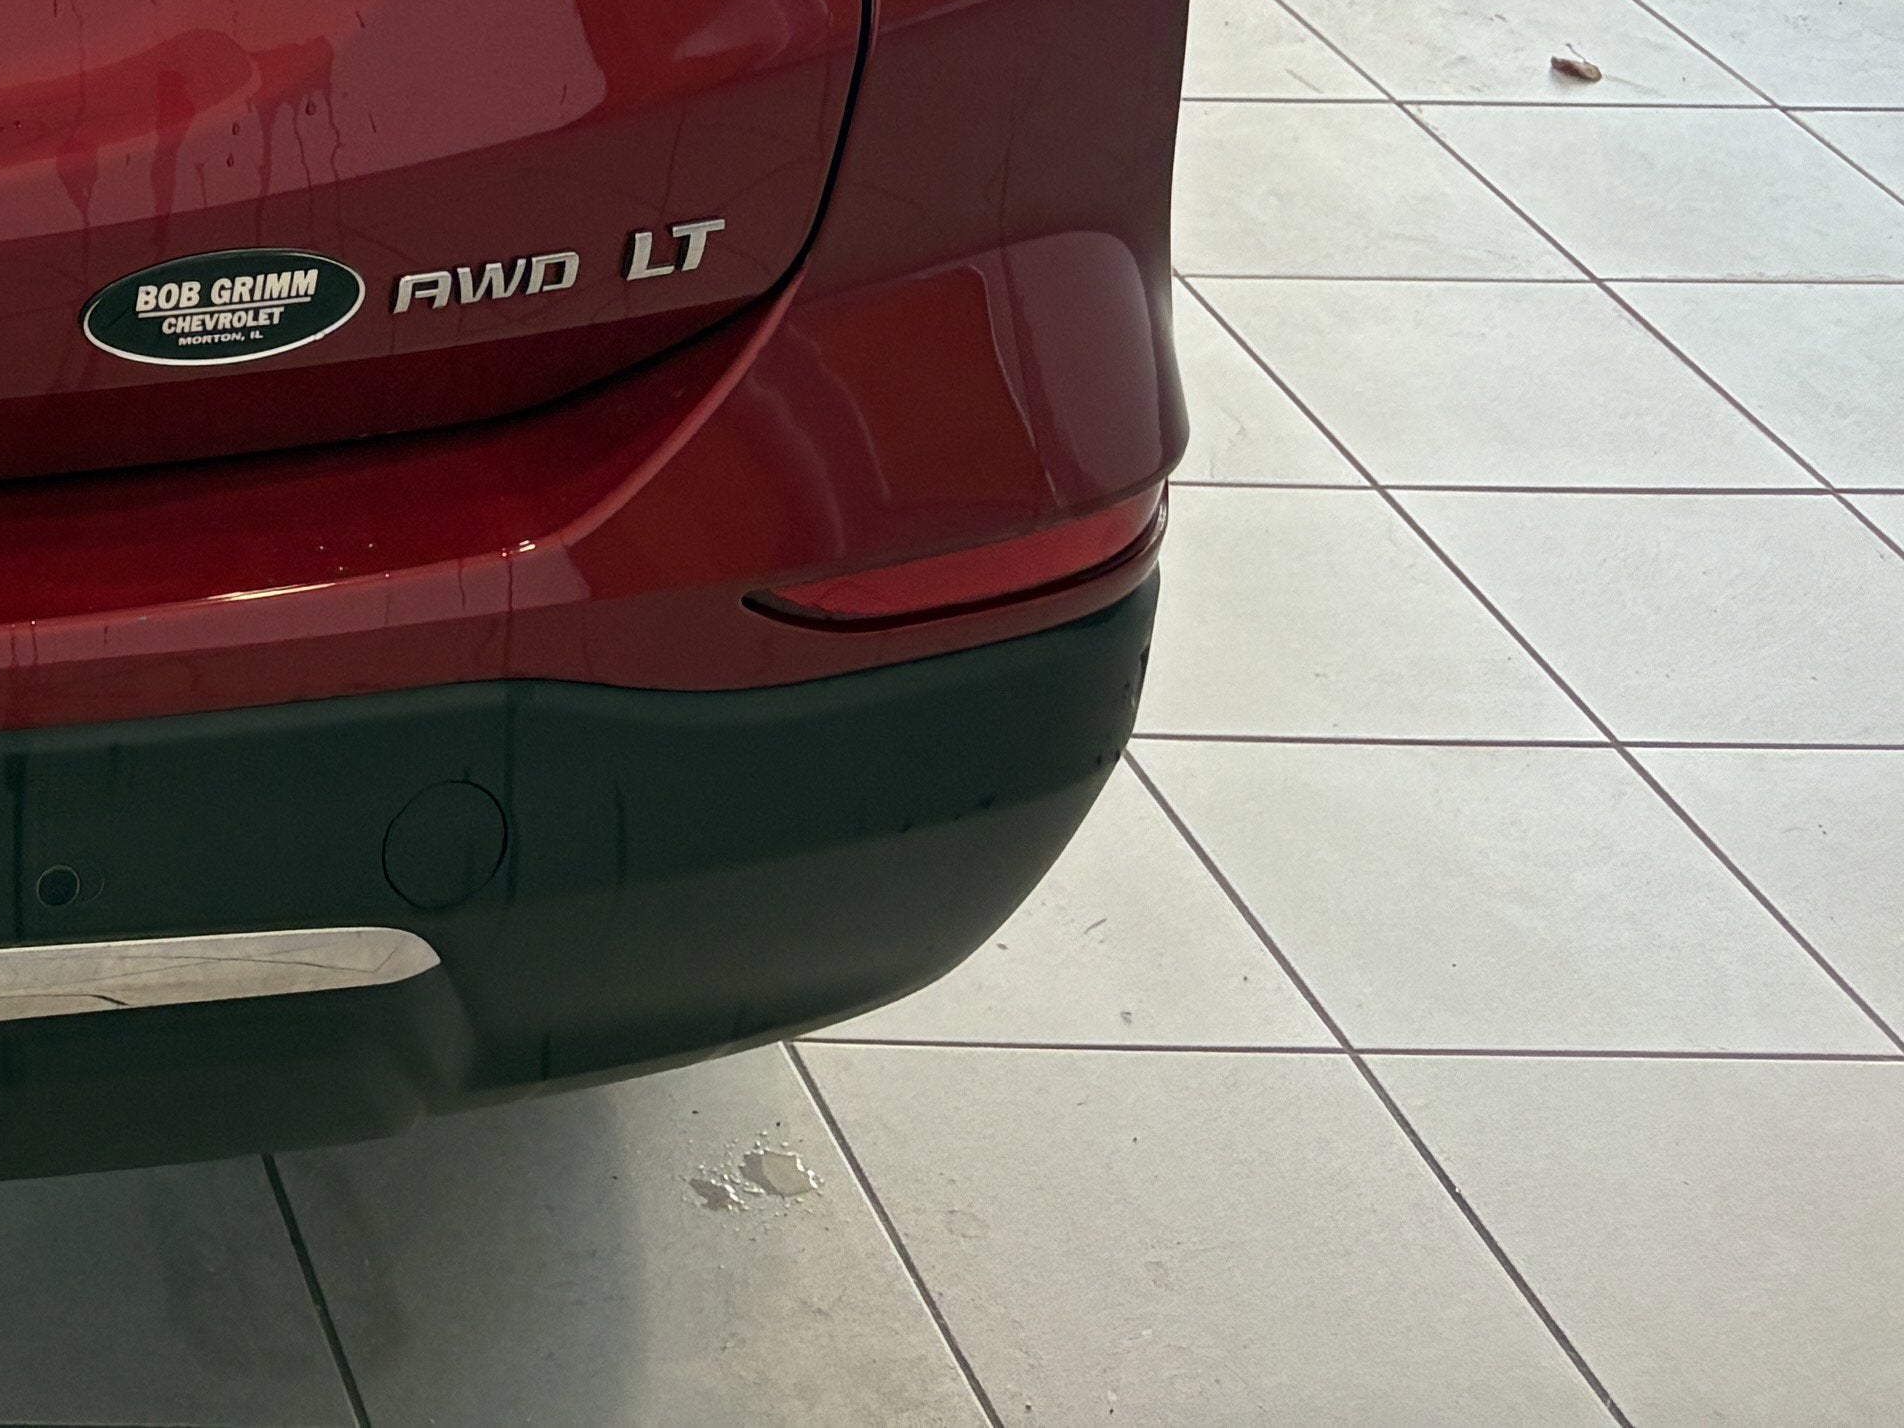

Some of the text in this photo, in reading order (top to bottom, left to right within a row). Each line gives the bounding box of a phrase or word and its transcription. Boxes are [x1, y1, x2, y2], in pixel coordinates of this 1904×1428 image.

[391, 217, 727, 315] AWD LT
[135, 268, 319, 312] BOB GRIMM
[161, 306, 285, 335] CHEVROLET
[177, 330, 264, 346] MORTON, IL
